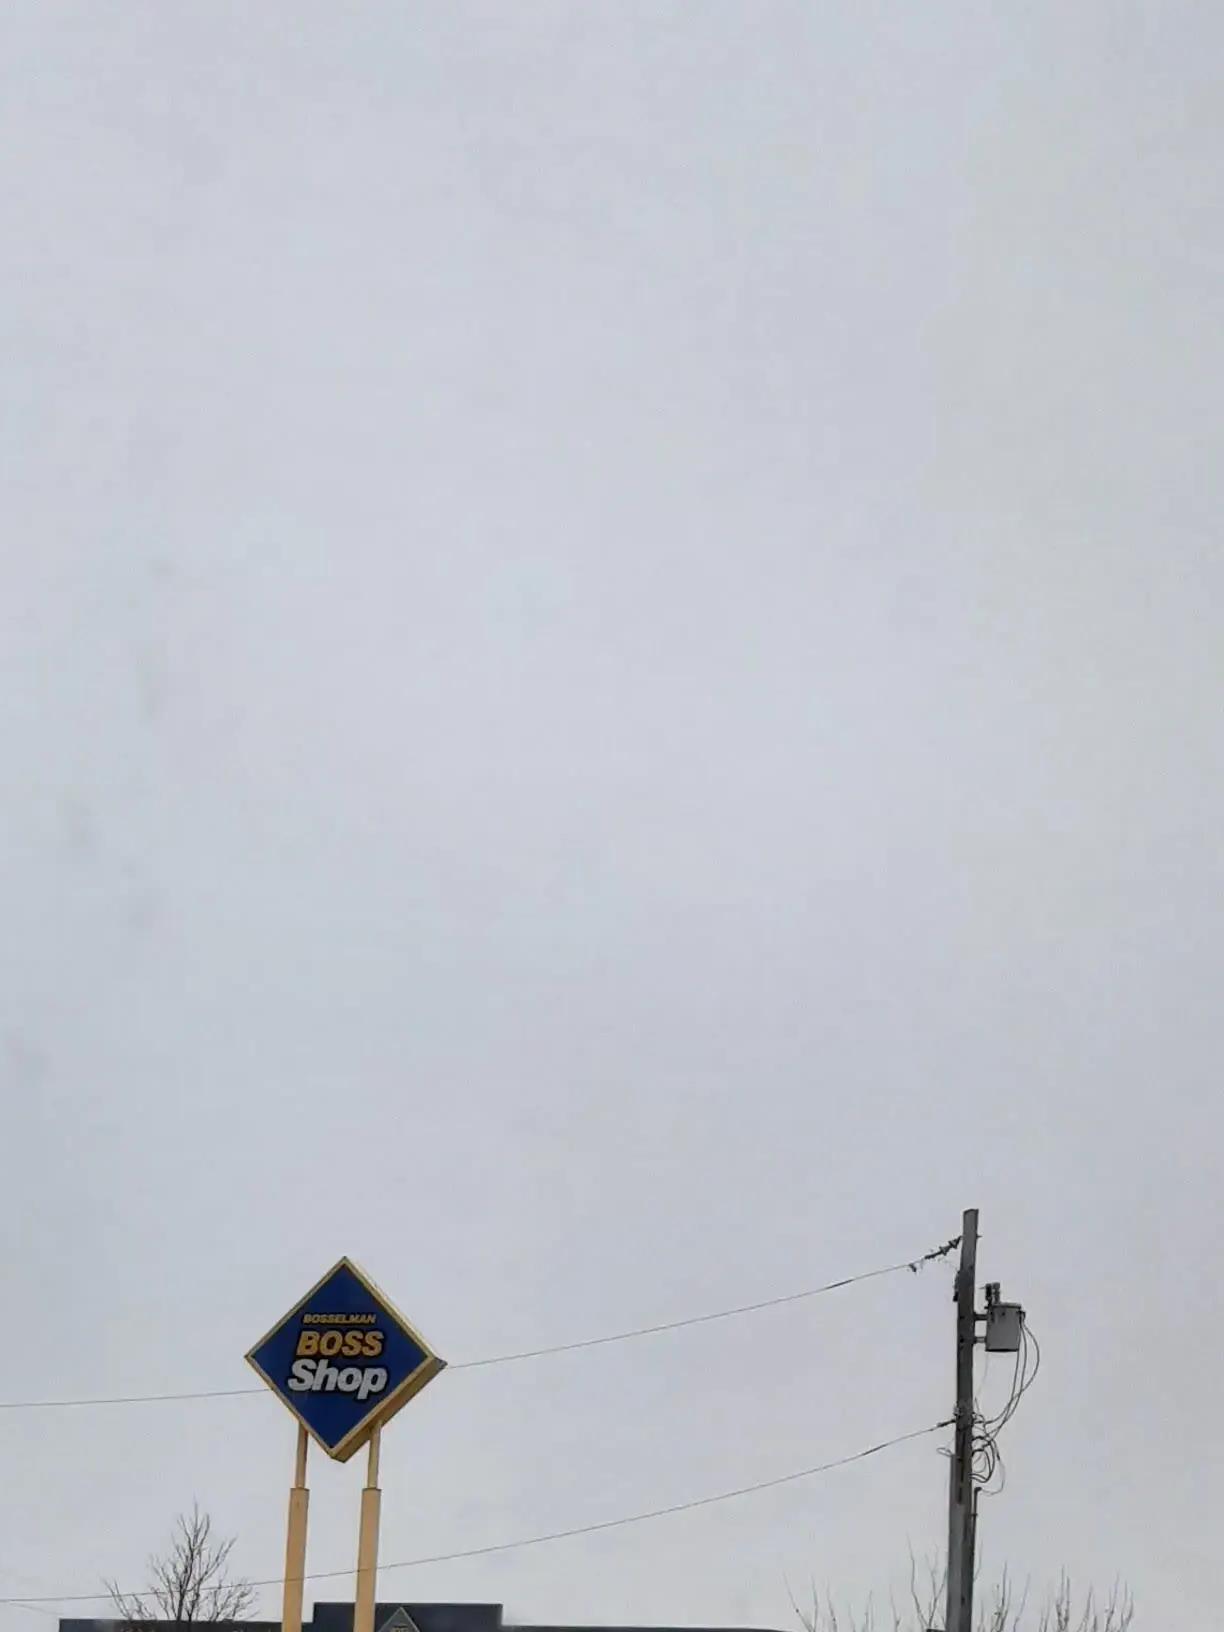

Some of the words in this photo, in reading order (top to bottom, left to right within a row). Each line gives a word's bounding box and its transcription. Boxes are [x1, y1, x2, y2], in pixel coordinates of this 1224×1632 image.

[303, 1314, 376, 1324] BOSSELMAN
[296, 1330, 385, 1357] BOSS
[287, 1358, 388, 1400] Shop
